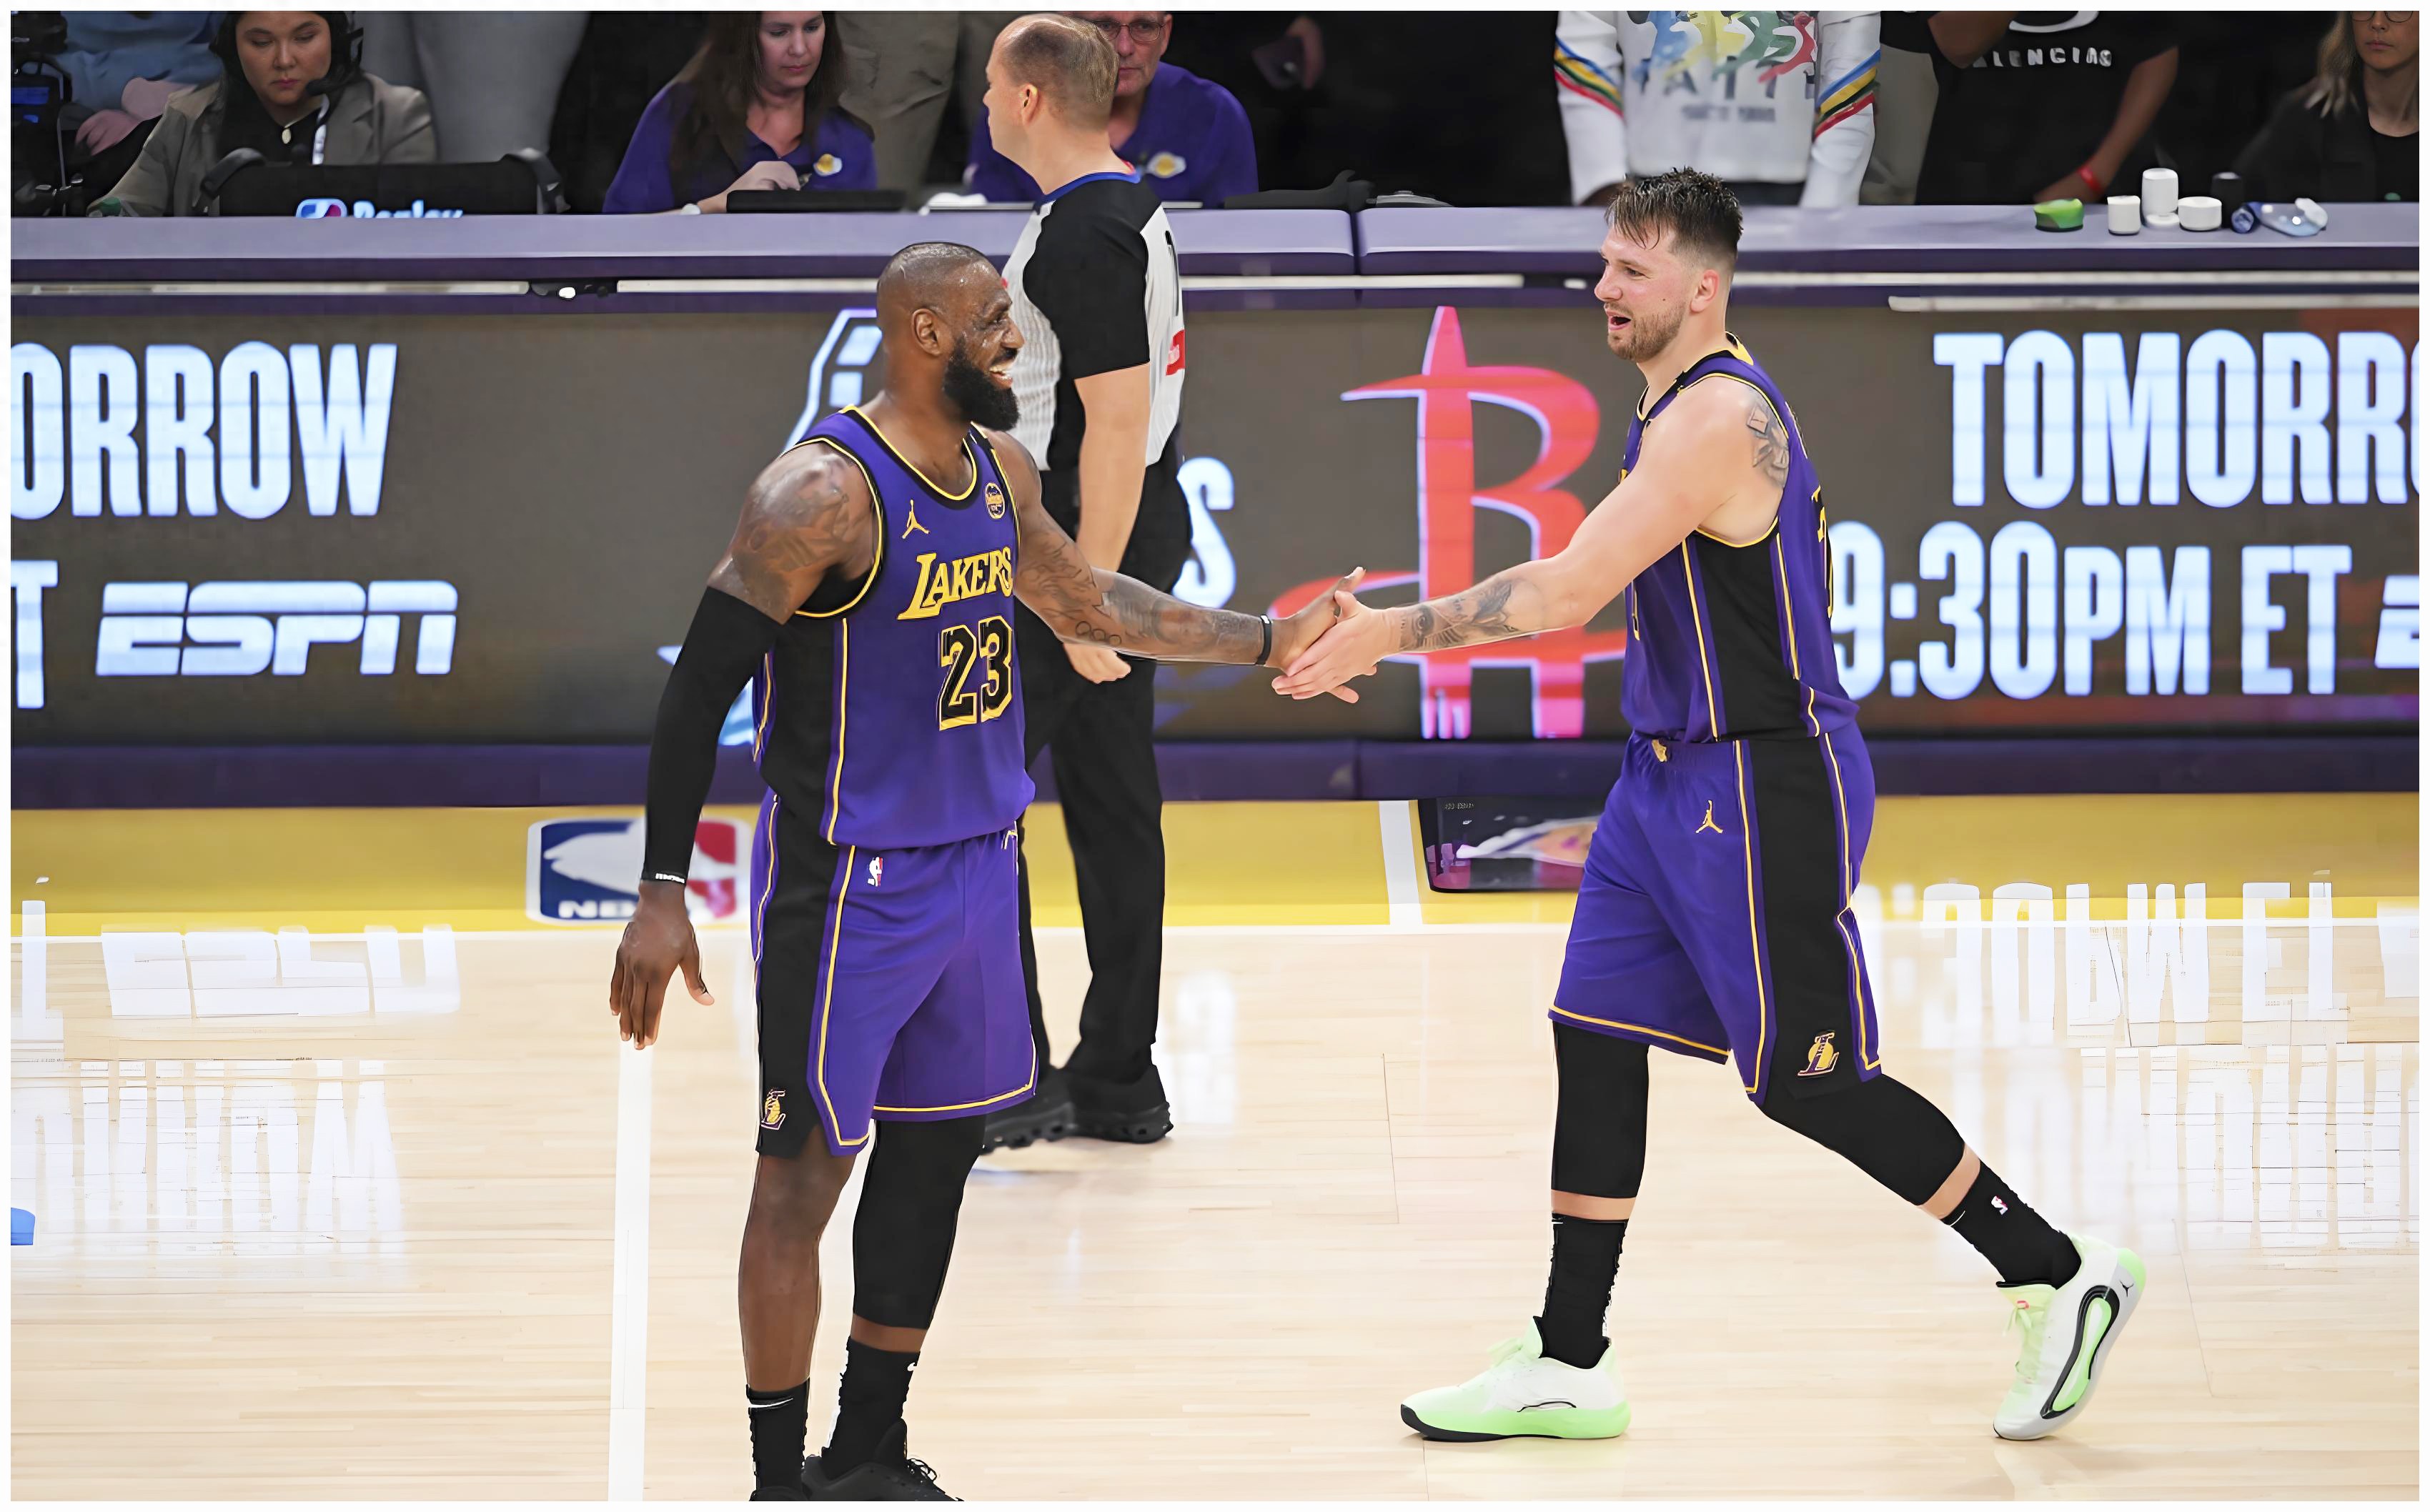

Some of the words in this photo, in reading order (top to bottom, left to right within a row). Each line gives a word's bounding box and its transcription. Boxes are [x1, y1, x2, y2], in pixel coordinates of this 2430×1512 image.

[1933, 329, 2420, 508] TOMORR
[96, 581, 458, 675] ESPN
[898, 546, 1013, 620] LAKERS
[1825, 521, 2211, 700] 9:30PM
[2241, 545, 2352, 694] ET
[939, 615, 1013, 731] 23
[558, 900, 638, 920] NB
